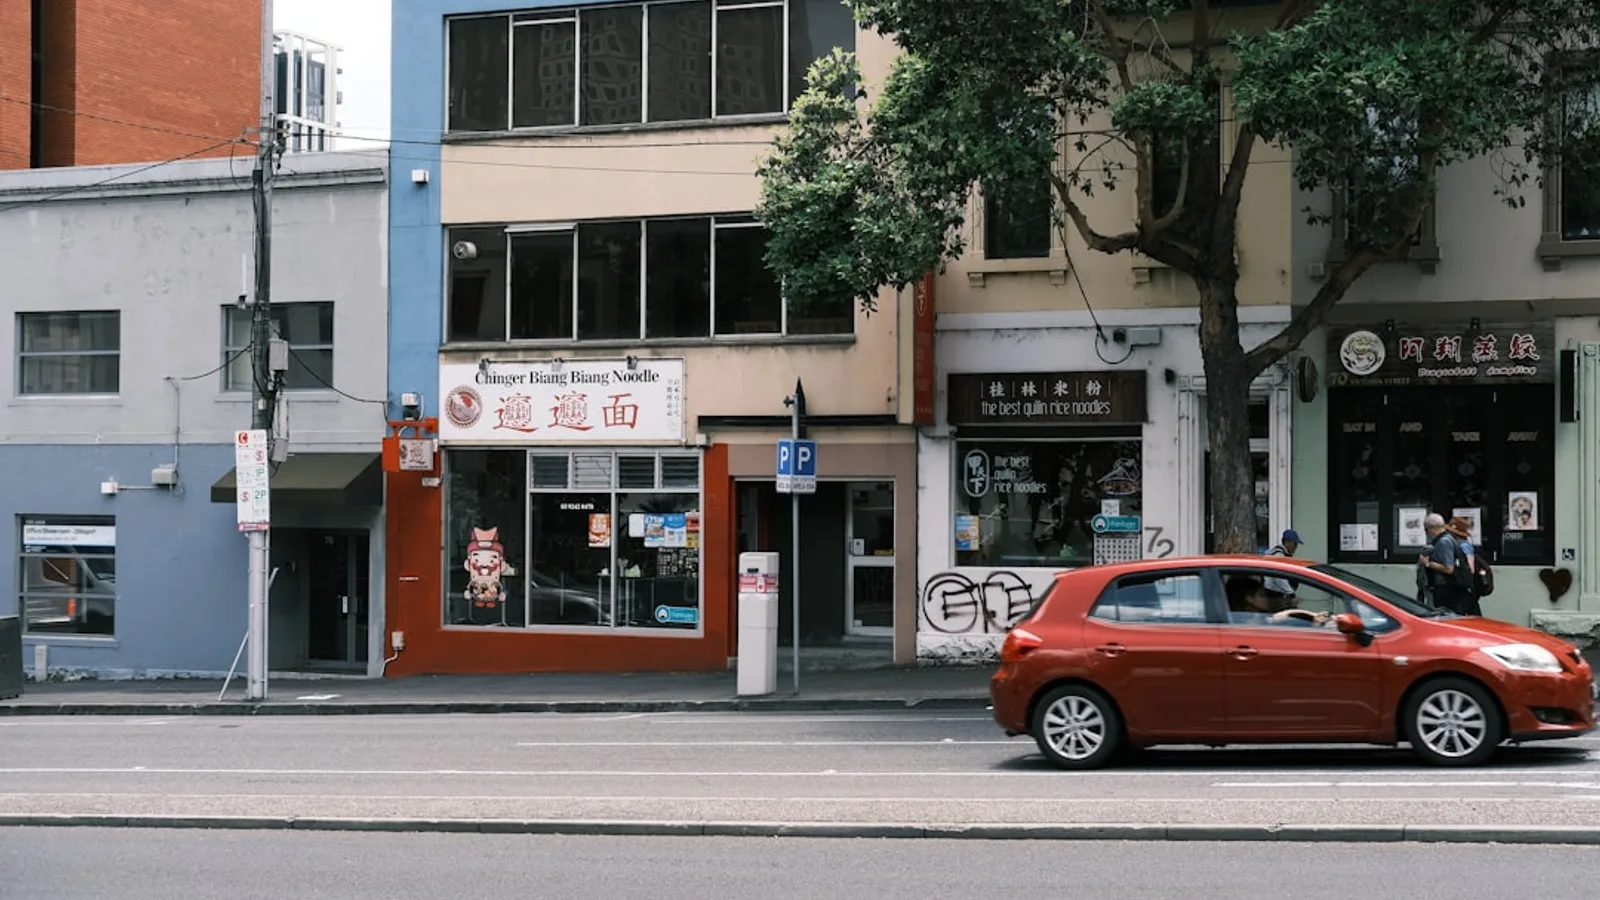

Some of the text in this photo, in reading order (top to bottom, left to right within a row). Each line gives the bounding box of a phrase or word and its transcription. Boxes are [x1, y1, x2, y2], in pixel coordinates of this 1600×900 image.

[475, 369, 660, 387] Chinger Biang Biang Noodle
[981, 401, 997, 416] the
[999, 401, 1021, 416] best
[1050, 400, 1070, 416] rice
[1072, 400, 1112, 416] noodles
[780, 446, 790, 470] P
[798, 446, 811, 471] P
[1013, 481, 1047, 494] noodles
[1144, 526, 1175, 558] 72
